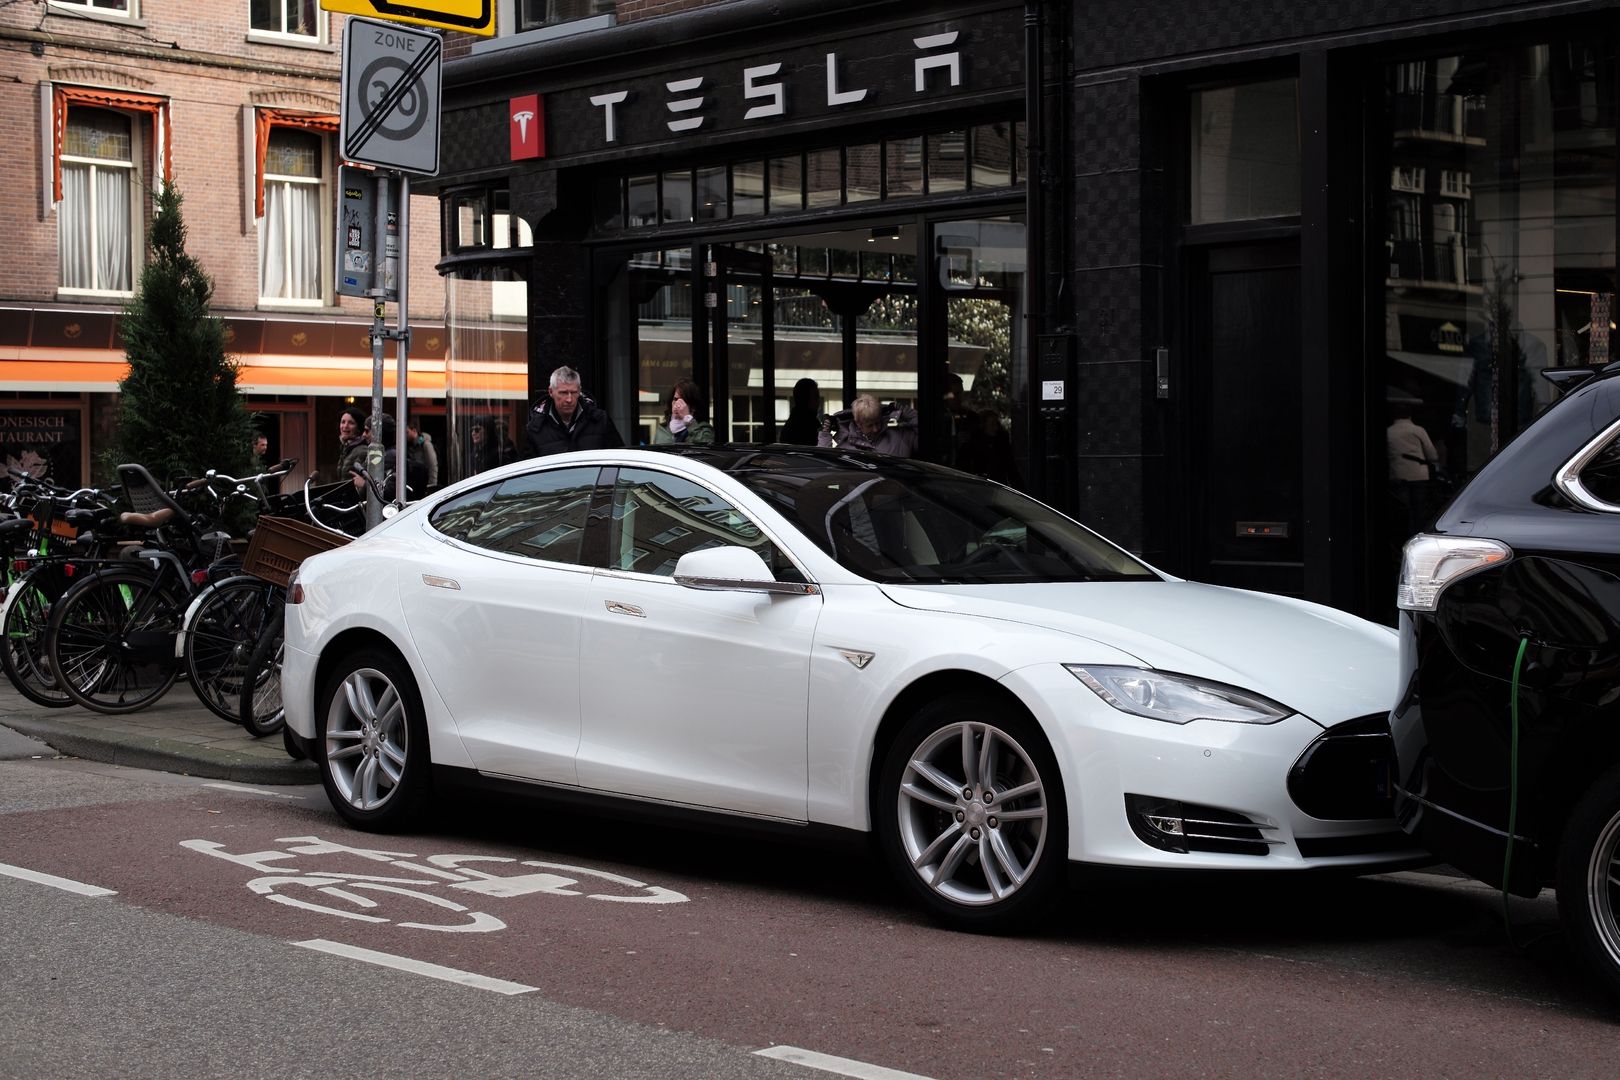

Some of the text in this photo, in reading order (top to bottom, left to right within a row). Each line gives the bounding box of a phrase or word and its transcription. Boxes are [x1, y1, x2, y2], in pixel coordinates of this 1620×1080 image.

[374, 31, 416, 53] ZONE
[370, 80, 417, 116] 30
[589, 30, 961, 142] TESLA
[1054, 386, 1062, 394] 29
